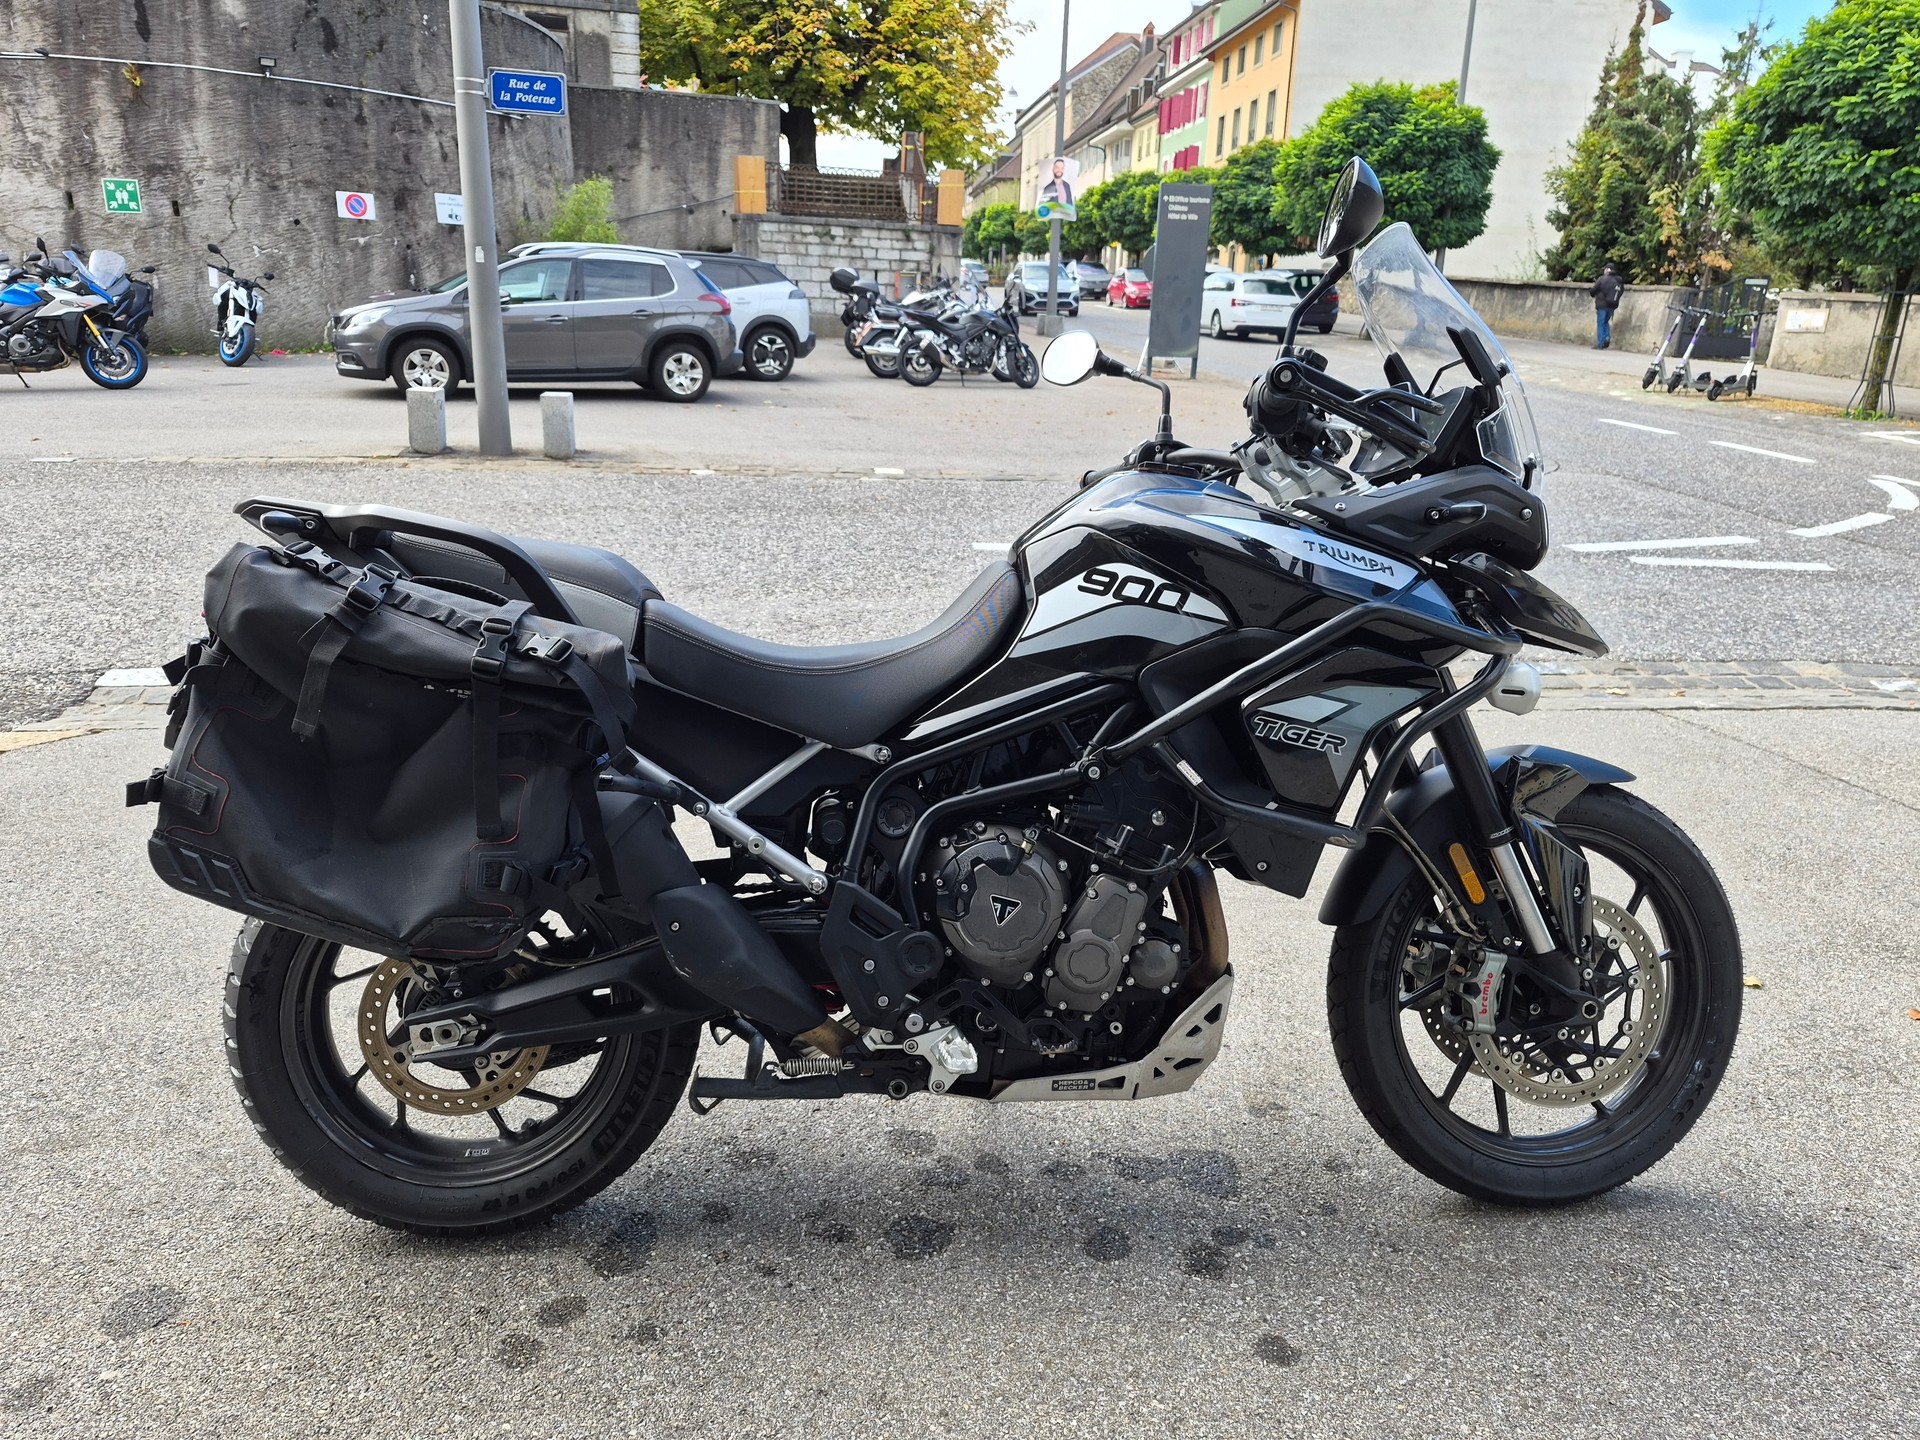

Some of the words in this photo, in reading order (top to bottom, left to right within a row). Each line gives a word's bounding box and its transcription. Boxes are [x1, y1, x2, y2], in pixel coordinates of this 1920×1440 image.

[500, 90, 510, 101] la
[515, 92, 556, 104] Poterne
[508, 79, 530, 89] Rue
[533, 80, 546, 91] de
[1303, 540, 1394, 576] TRIUMPH
[1077, 568, 1191, 614] 900
[1254, 715, 1347, 755] TIGER
[1479, 972, 1493, 1015] brembo
